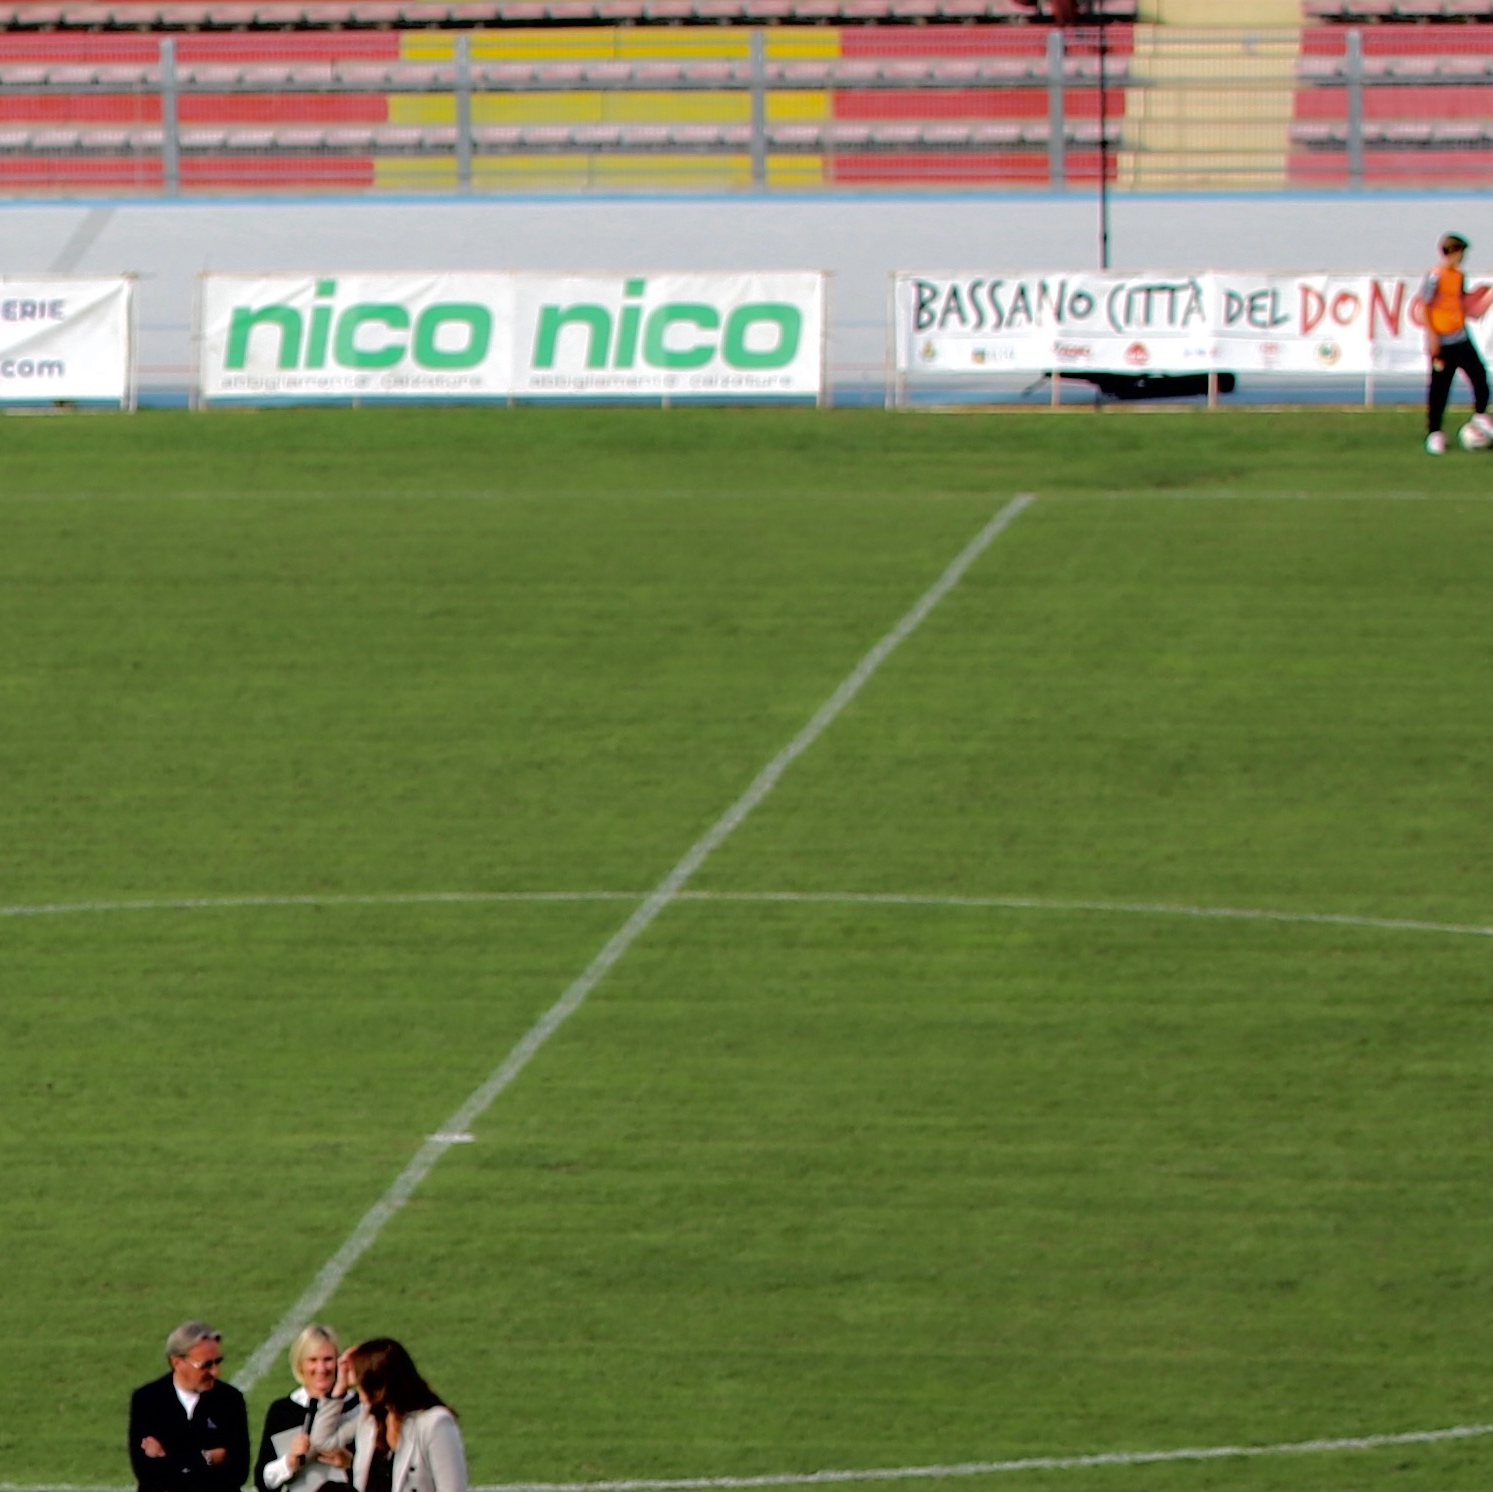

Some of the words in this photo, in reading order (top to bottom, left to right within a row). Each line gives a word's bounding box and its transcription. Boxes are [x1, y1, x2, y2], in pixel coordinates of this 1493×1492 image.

[223, 279, 493, 370] nico
[531, 279, 803, 370] nico
[911, 279, 1096, 333] BASSANO
[1224, 287, 1290, 328] DEL
